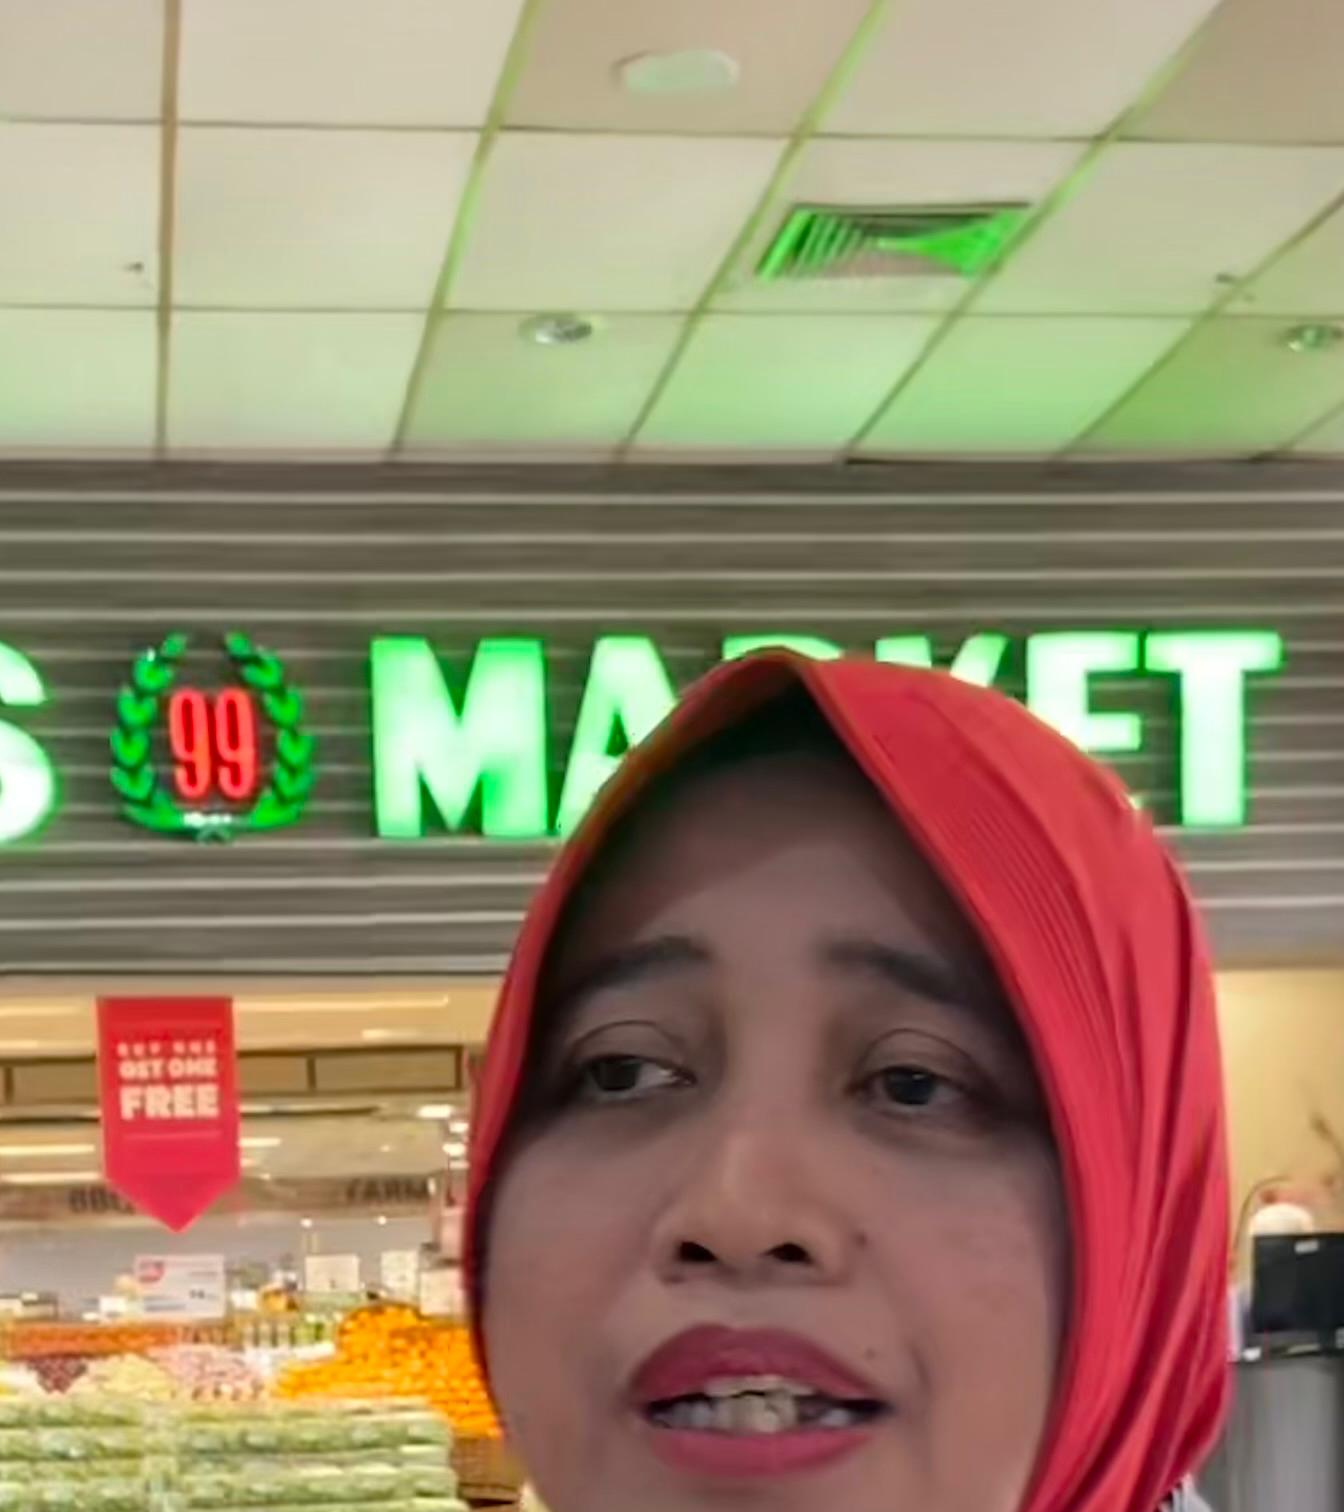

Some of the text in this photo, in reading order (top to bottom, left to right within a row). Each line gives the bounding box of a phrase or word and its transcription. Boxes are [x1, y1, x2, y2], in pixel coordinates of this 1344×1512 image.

[169, 686, 256, 798] 99
[370, 631, 1284, 837] MAET
[119, 1057, 218, 1079] GET ONE
[120, 1083, 220, 1120] FREE
